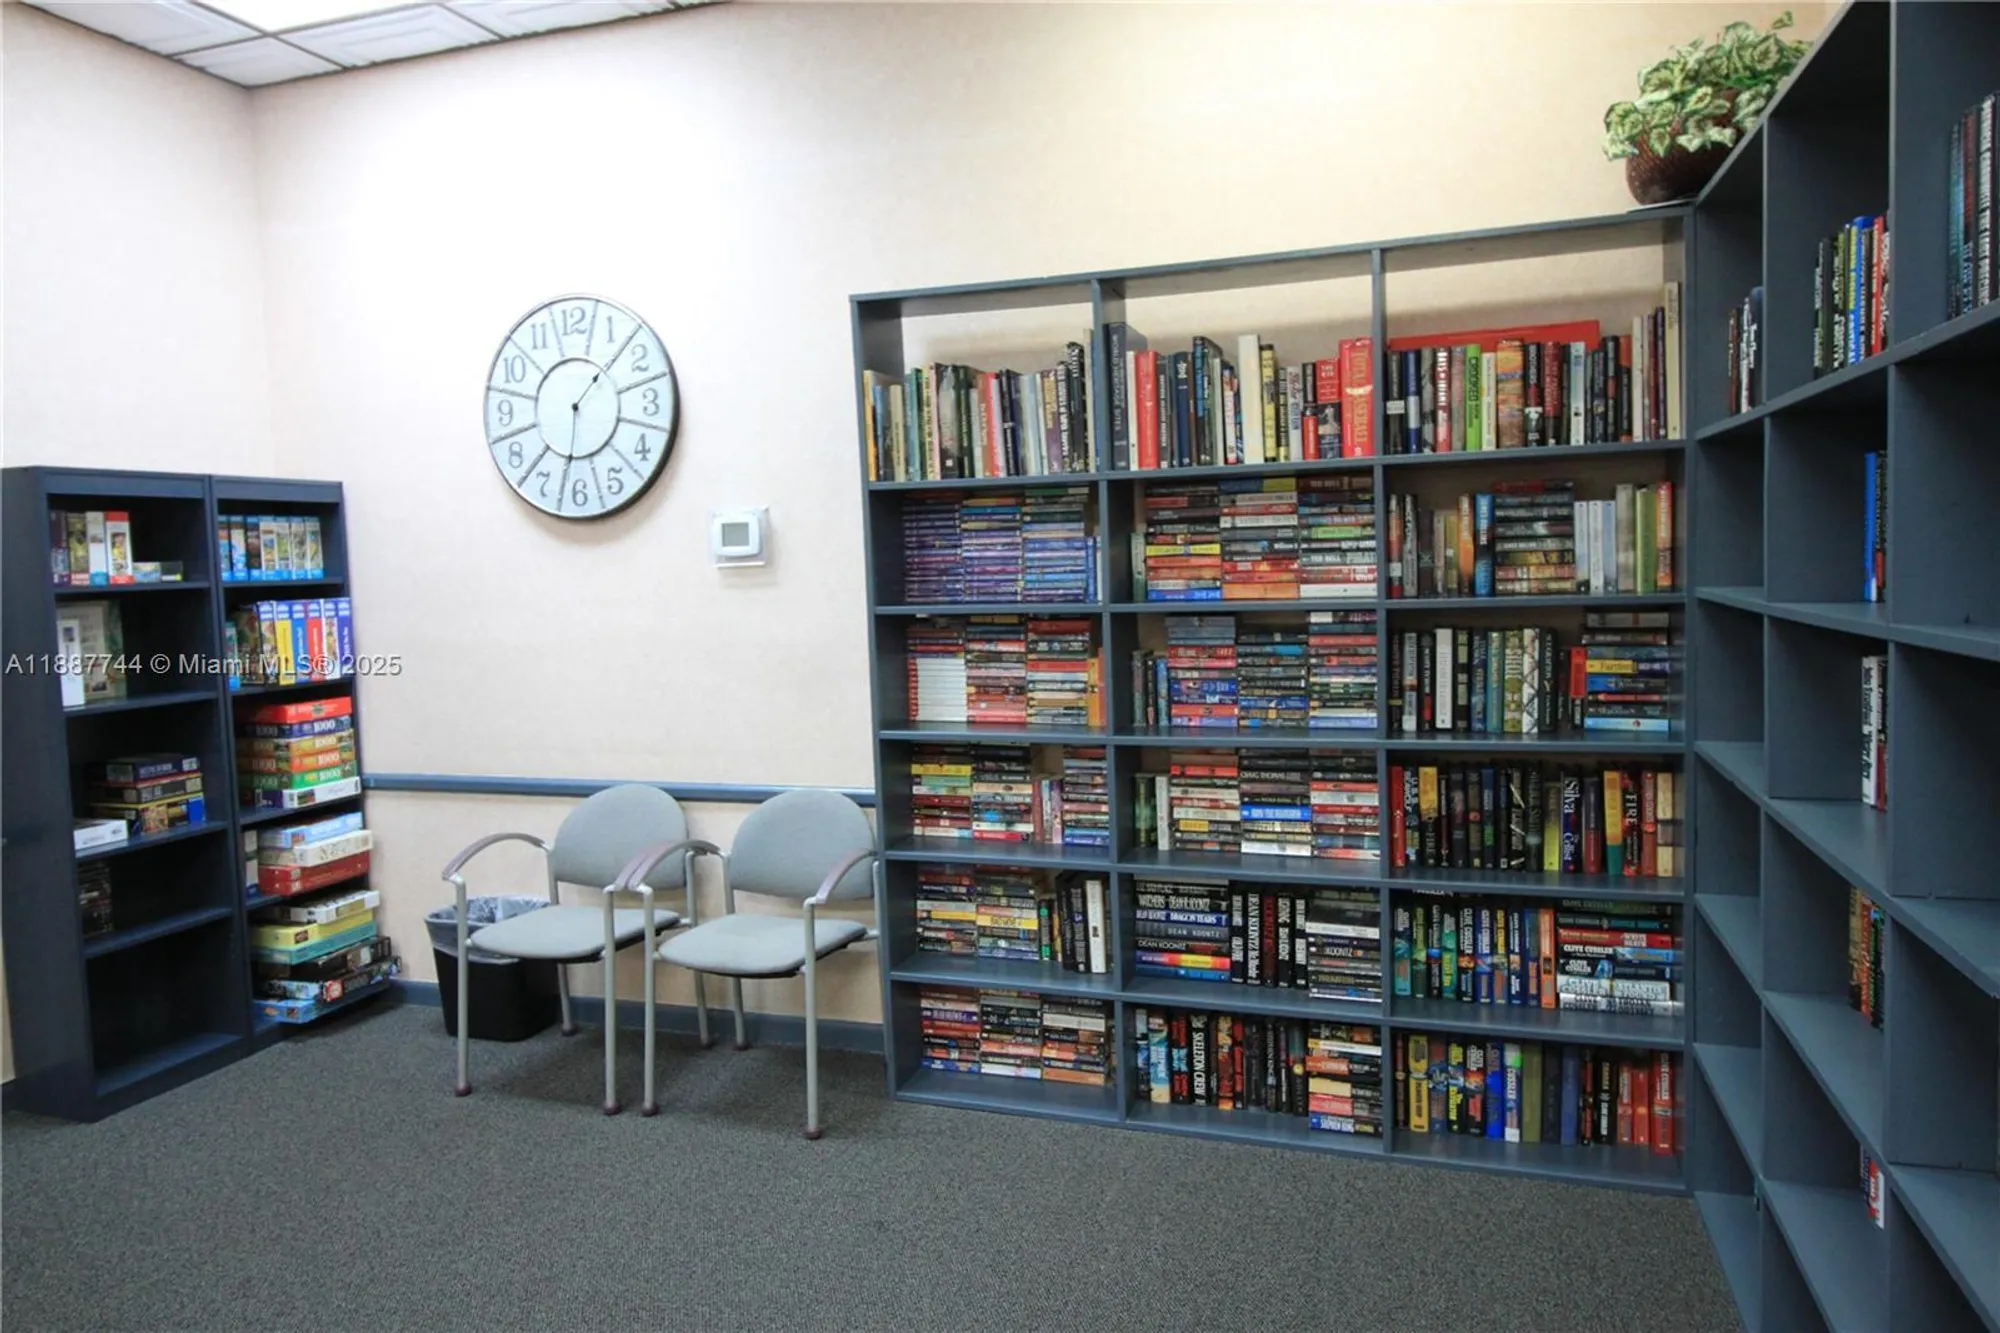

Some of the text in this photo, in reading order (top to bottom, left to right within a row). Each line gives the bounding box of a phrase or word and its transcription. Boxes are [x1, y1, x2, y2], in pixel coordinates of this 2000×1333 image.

[561, 306, 587, 336] 12
[606, 315, 616, 343] 1
[531, 322, 550, 350] 11
[503, 355, 527, 384] 10
[631, 344, 650, 373] 2
[497, 399, 514, 427] 9
[642, 387, 660, 417] 3
[508, 441, 524, 469] 8
[633, 432, 652, 462] 4
[536, 470, 551, 498] 7
[572, 479, 589, 507] 6
[606, 466, 625, 495] 5
[1563, 780, 1580, 814] Silva
[1626, 794, 1638, 827] FIRE
[1248, 894, 1260, 917] DEAN
[1191, 929, 1220, 938] KOONTZ
[1248, 917, 1260, 949] KOONTZ
[1464, 908, 1473, 954] CLIVE CUSSLER
[1585, 946, 1614, 955] CUSSLER
[1192, 1032, 1207, 1096] SKELETON CREW
